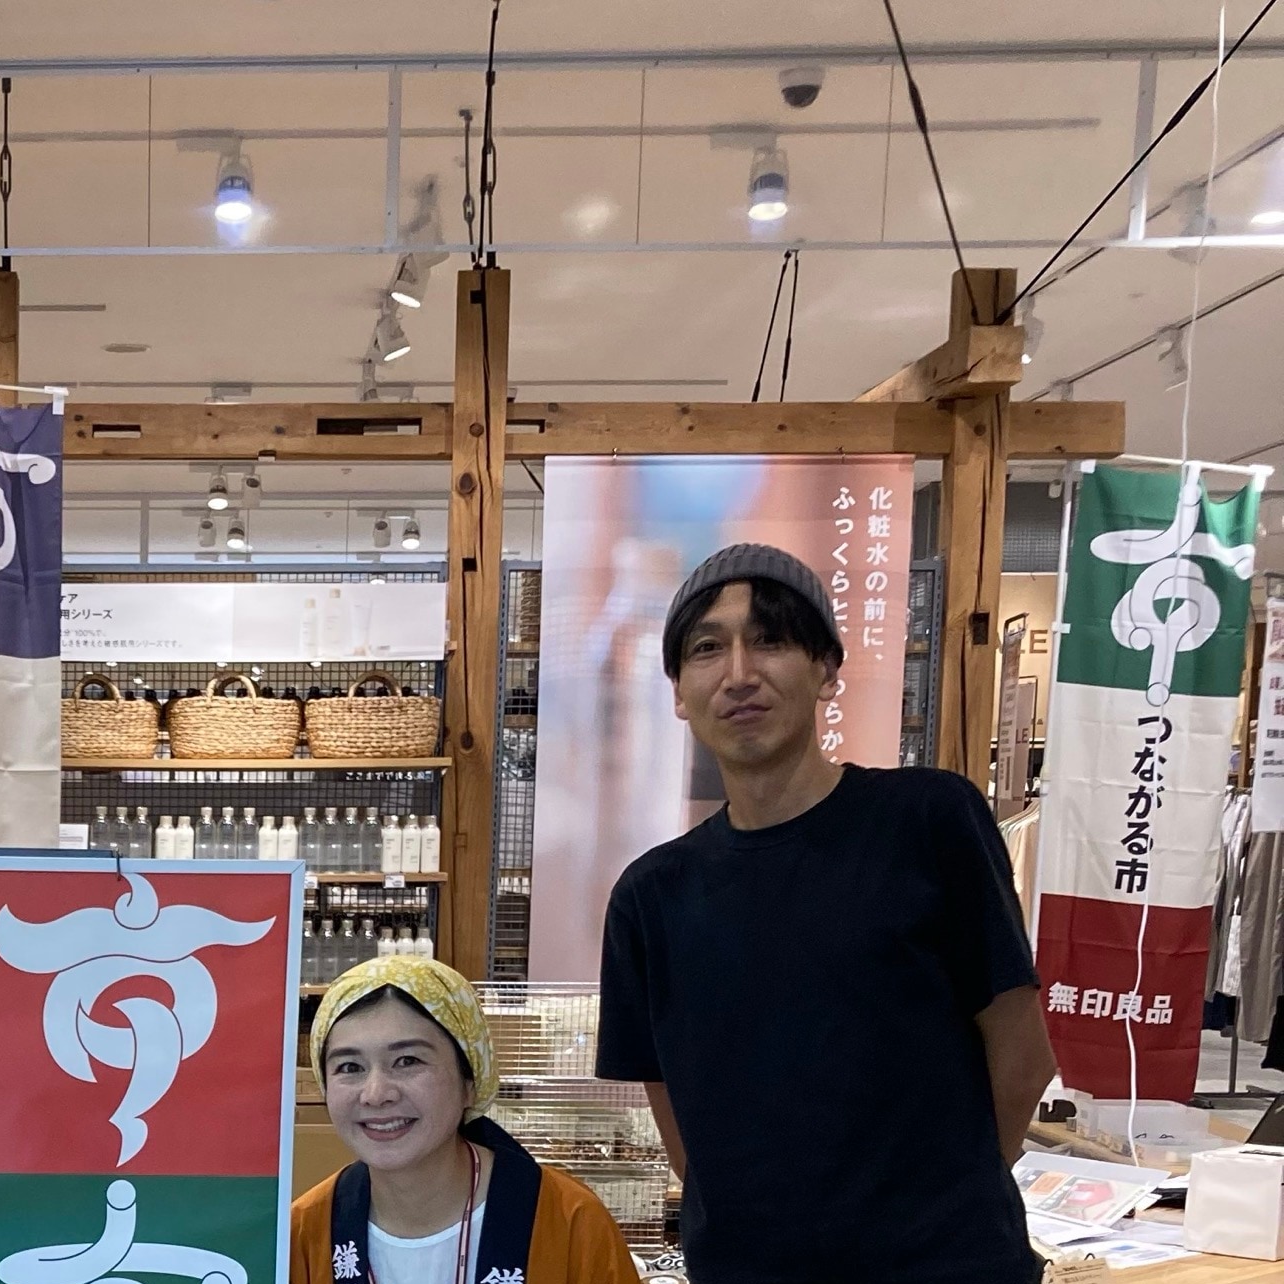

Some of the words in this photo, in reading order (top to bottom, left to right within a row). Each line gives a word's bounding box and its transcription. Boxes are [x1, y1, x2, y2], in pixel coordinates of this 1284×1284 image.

[862, 486, 894, 661] 化粧水の前に、
[1114, 714, 1172, 894] つながる市
[1047, 980, 1175, 1026] 無印良品
